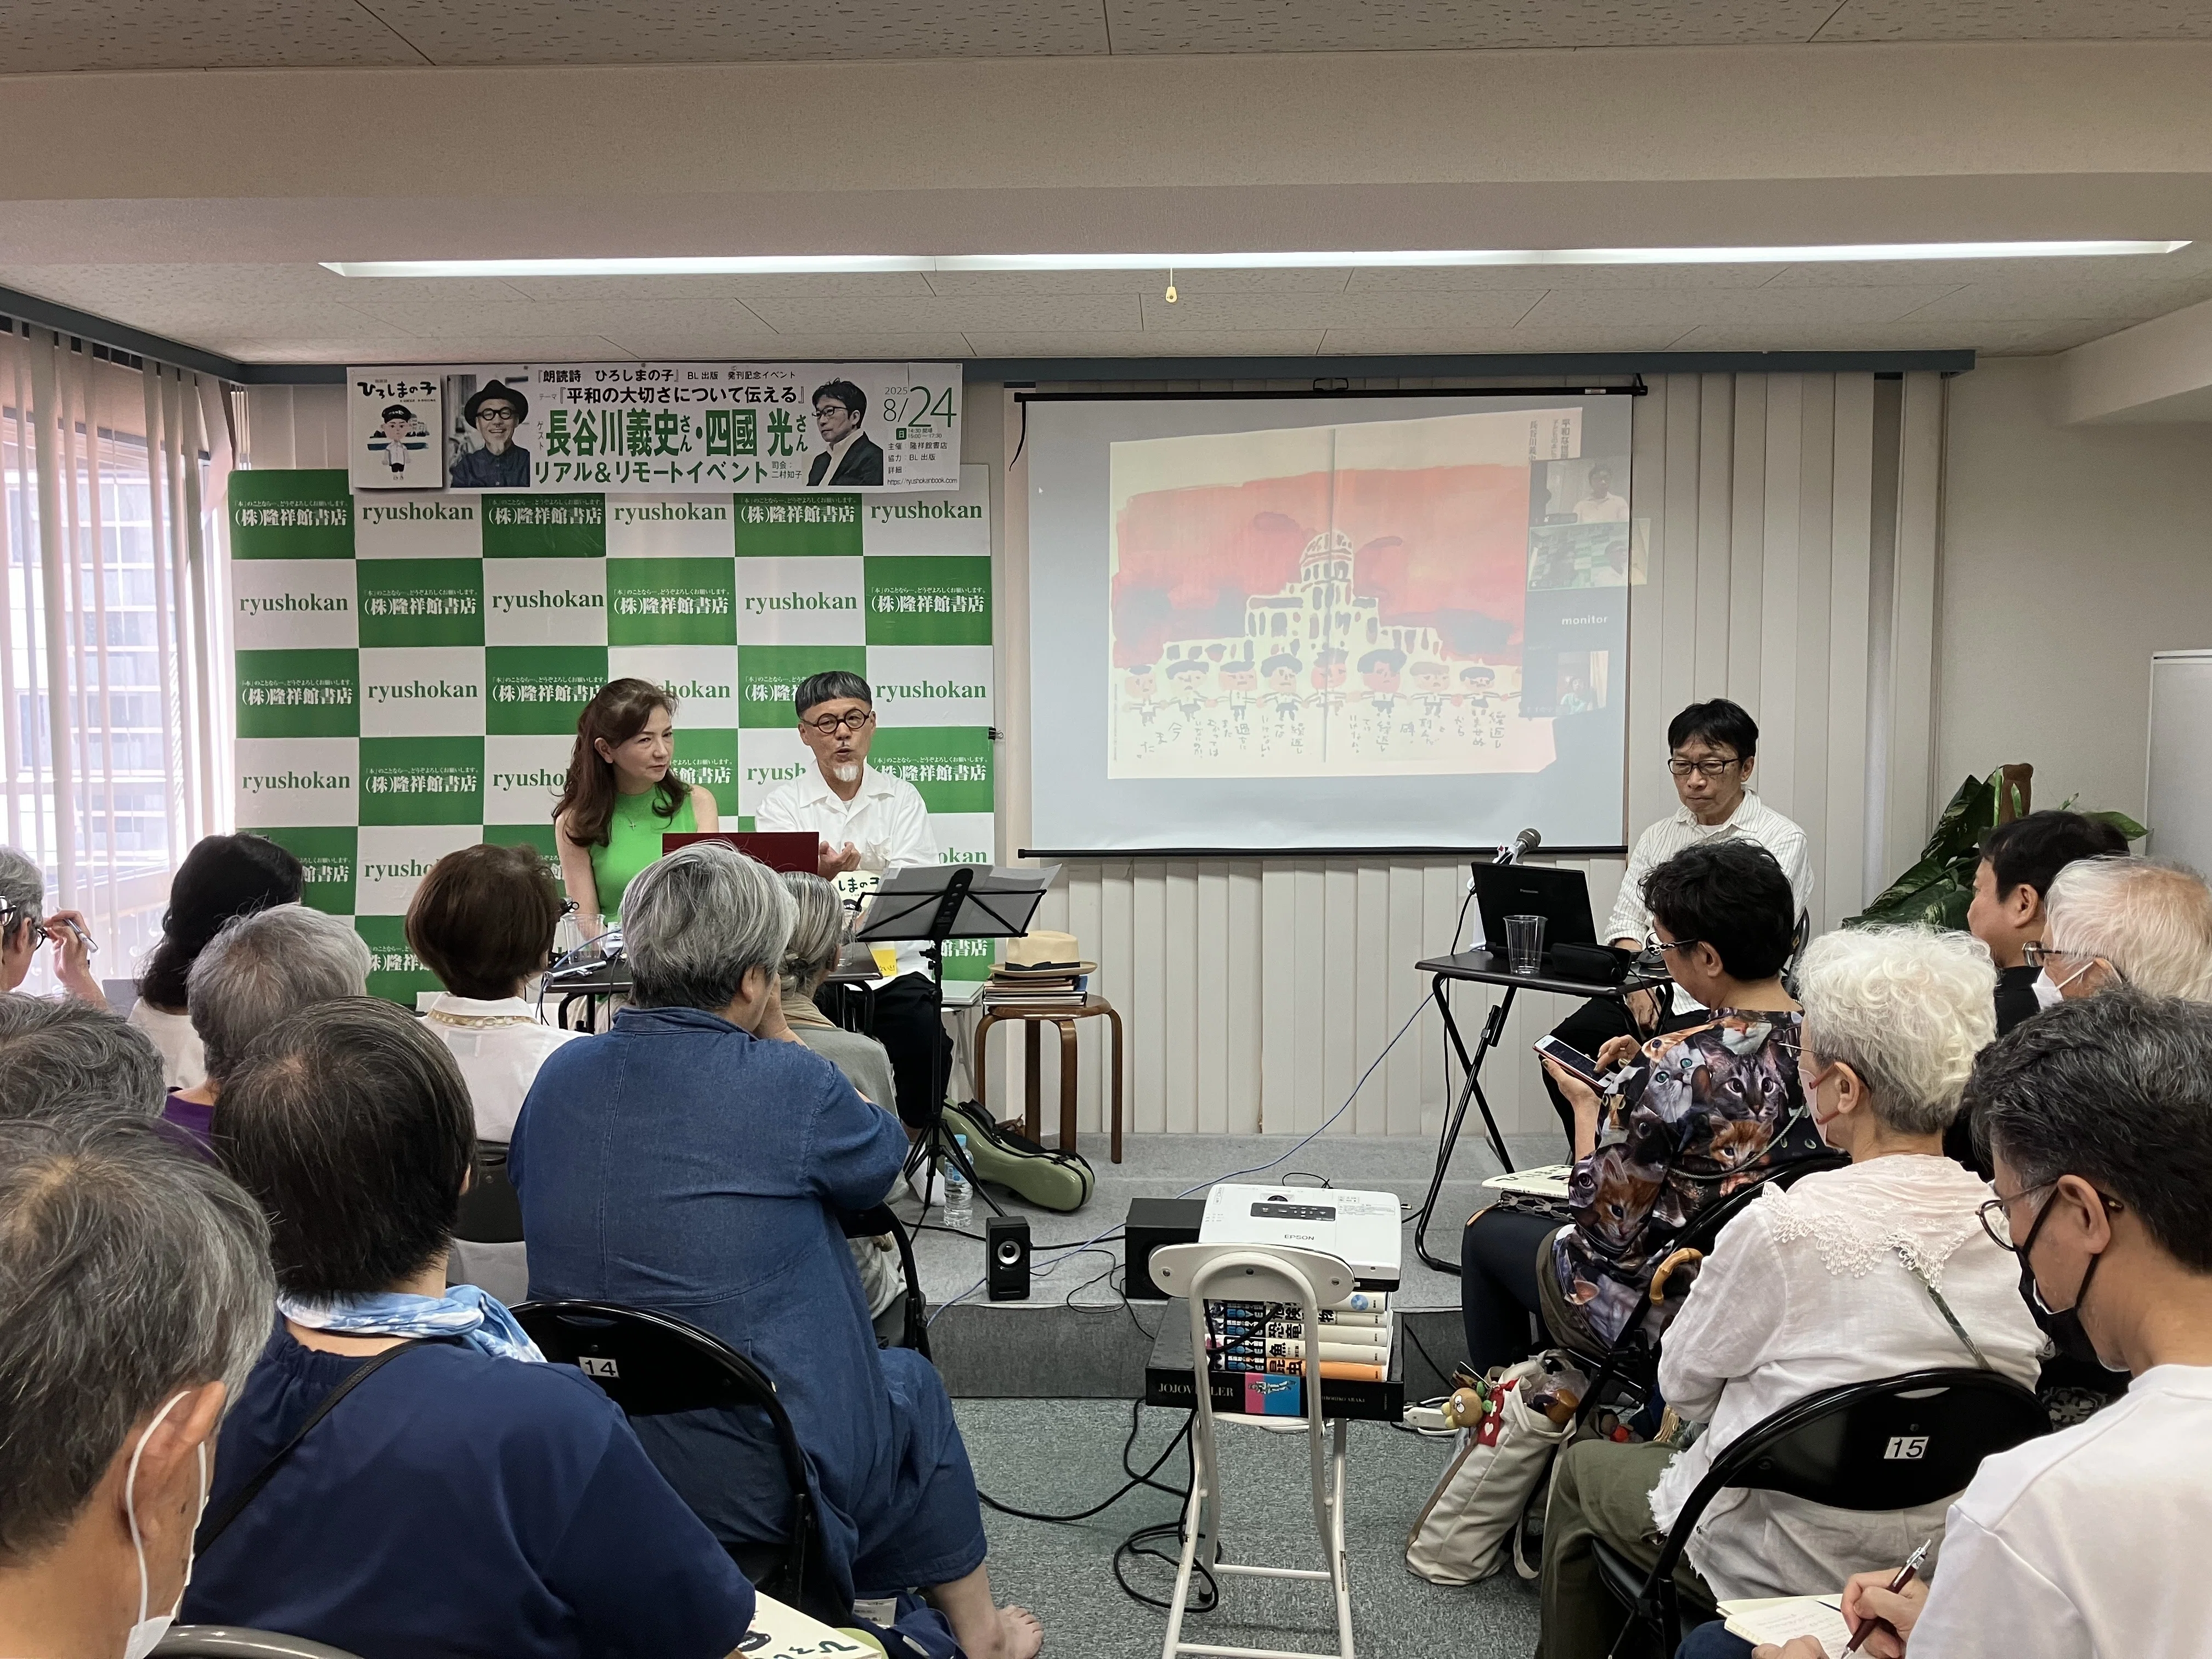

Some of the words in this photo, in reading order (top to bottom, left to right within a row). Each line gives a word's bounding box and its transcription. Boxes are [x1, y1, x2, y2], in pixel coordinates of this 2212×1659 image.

[727, 371, 795, 380] 発刊記念イベント
[357, 381, 437, 399] ひろしまの子
[884, 387, 908, 395] 2025
[771, 471, 802, 479] 二村知子
[363, 502, 473, 524] ryushokan
[614, 502, 727, 525] ryushokan
[871, 500, 982, 523] ryushokan
[240, 592, 348, 616] ryushokan
[493, 589, 605, 613] ryushokan
[745, 591, 857, 614] ryushokan
[1561, 614, 1608, 625] monitor
[368, 680, 478, 703] ryushokan
[876, 680, 986, 703] ryushokan
[243, 771, 350, 793] ryushokan
[493, 769, 568, 791] ryusho
[747, 763, 806, 785] ryush
[1268, 1322, 1302, 1339] 恐竜
[1269, 1342, 1286, 1357] 魚
[585, 1359, 616, 1376] 14
[1269, 1359, 1303, 1375] 昆虫
[1159, 1383, 1233, 1397] JOJOVLER
[1892, 1438, 1924, 1458] 15
